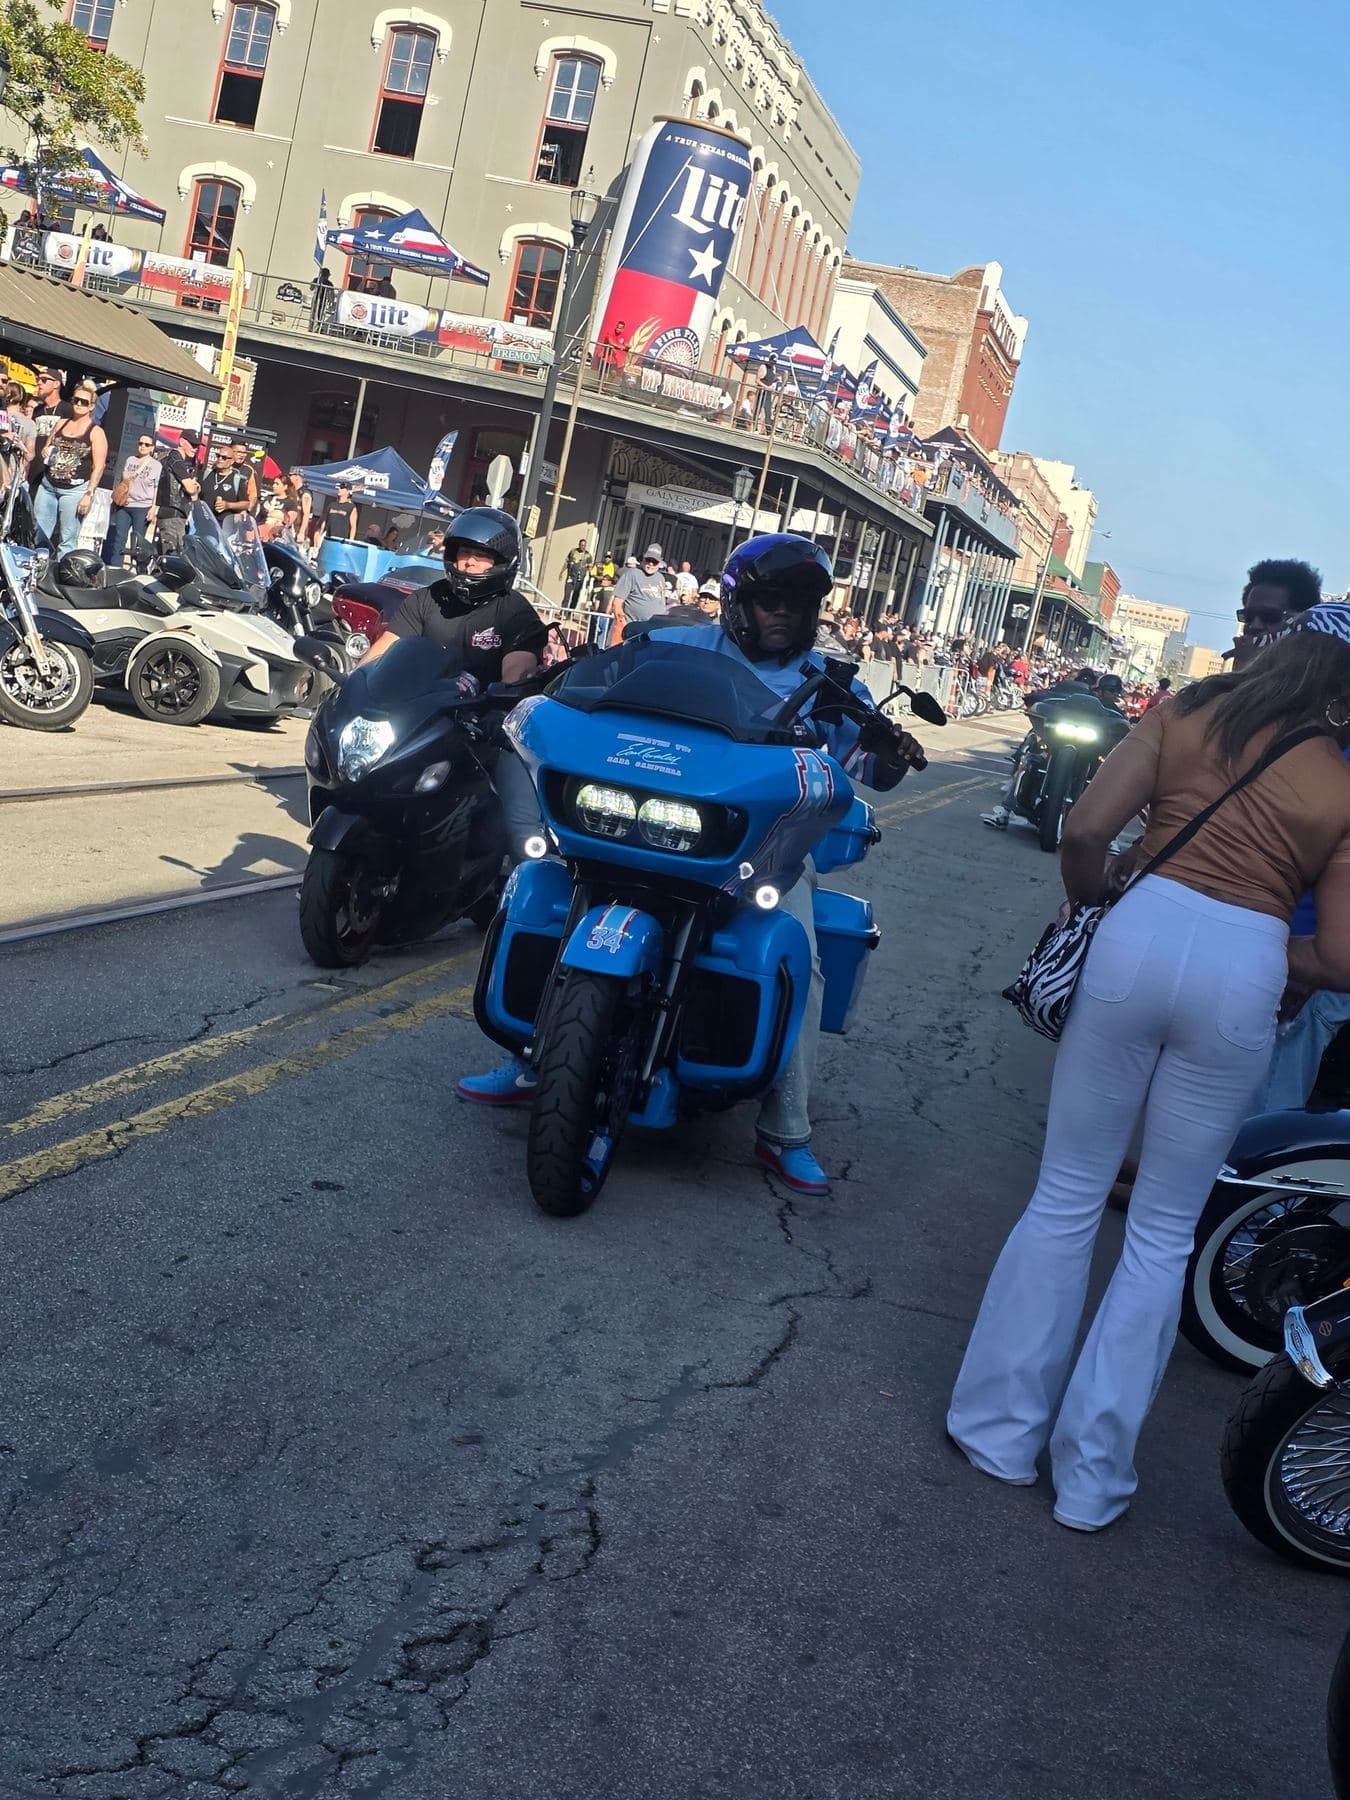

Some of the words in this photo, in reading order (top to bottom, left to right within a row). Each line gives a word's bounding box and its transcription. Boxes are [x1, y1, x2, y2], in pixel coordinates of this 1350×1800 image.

[665, 134, 672, 142] A
[674, 136, 698, 147] TRUE
[700, 142, 726, 157] TEXAS
[203, 271, 235, 289] STA
[368, 302, 409, 328] Lite
[658, 328, 682, 347] FINE
[495, 347, 545, 362] TREMON
[586, 927, 623, 954] 34
